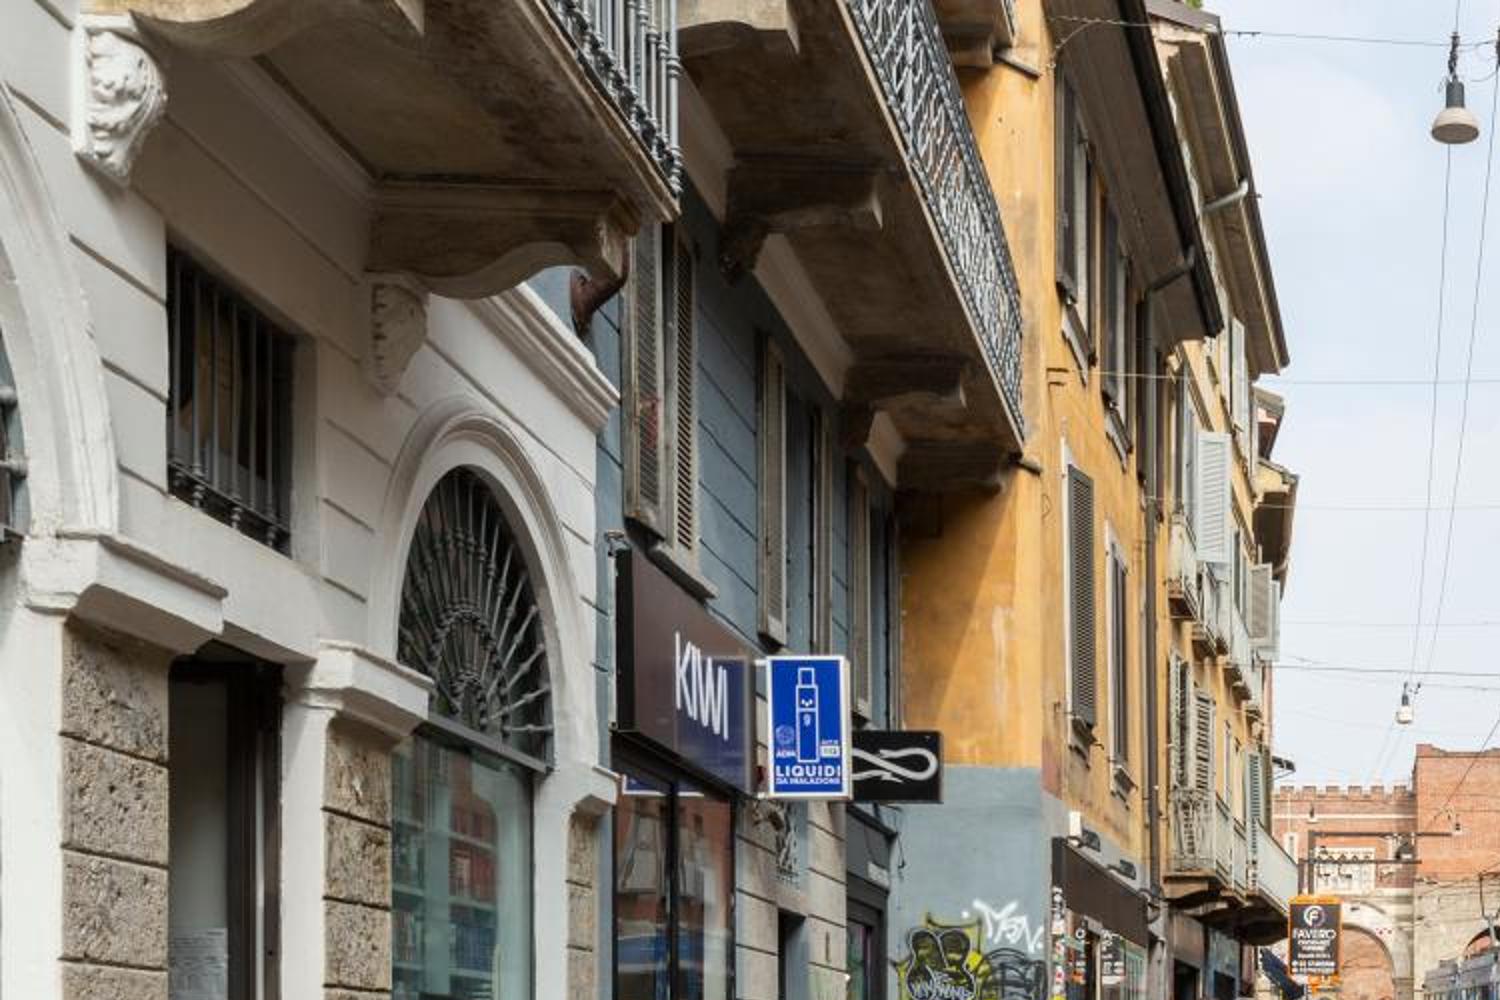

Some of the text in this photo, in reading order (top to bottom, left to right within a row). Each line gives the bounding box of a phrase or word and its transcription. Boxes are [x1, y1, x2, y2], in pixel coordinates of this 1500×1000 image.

[675, 631, 728, 741] KIWI
[775, 765, 841, 777] LIQUIDI
[1292, 928, 1337, 939] FAVERO
